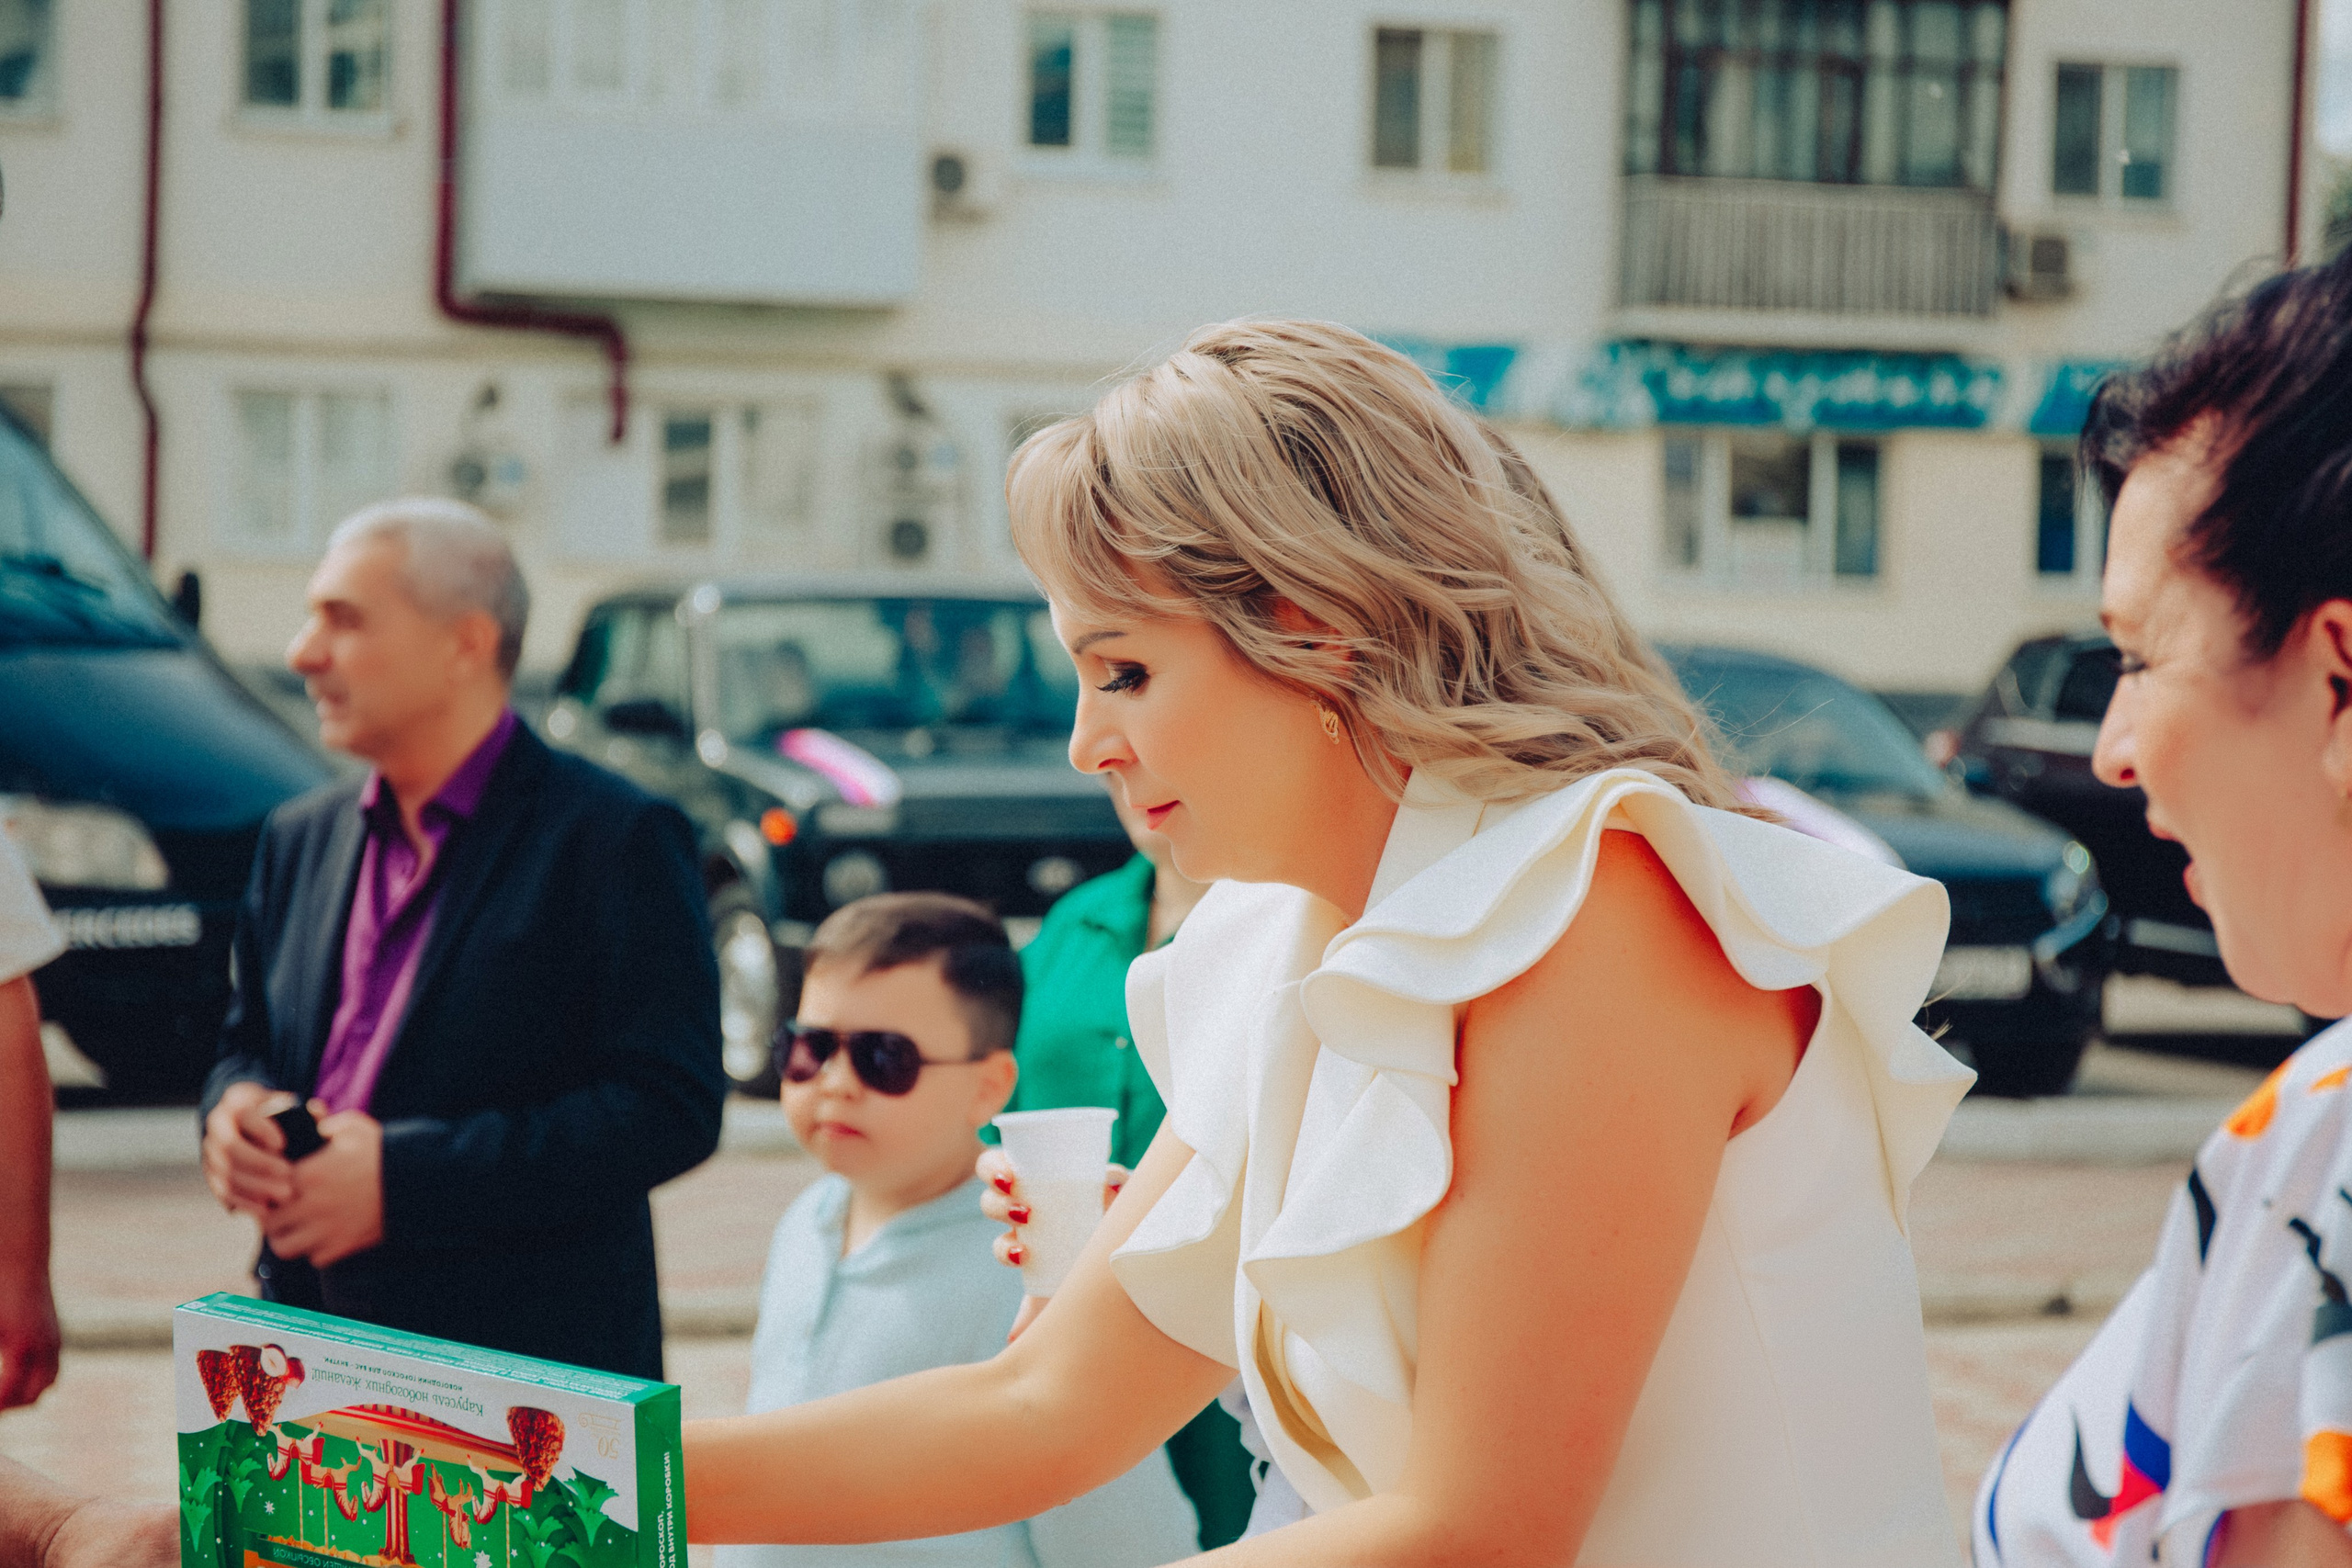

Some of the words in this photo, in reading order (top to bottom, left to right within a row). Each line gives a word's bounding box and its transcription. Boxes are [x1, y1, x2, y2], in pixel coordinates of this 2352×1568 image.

[355, 1363, 367, 1372] ВАС
[368, 1365, 381, 1374] ДЛЯ
[382, 1369, 416, 1383] ГОРОСКОП
[366, 1380, 428, 1403] новогодних
[417, 1377, 463, 1392] НОВОГОДНИЙ
[432, 1394, 484, 1417] Карусель
[597, 1435, 621, 1460] 50
[663, 1451, 673, 1509] КОРОБКИ!
[666, 1511, 675, 1552] ВНУТРИ
[273, 1548, 322, 1567] ОБСЫПКОЙ
